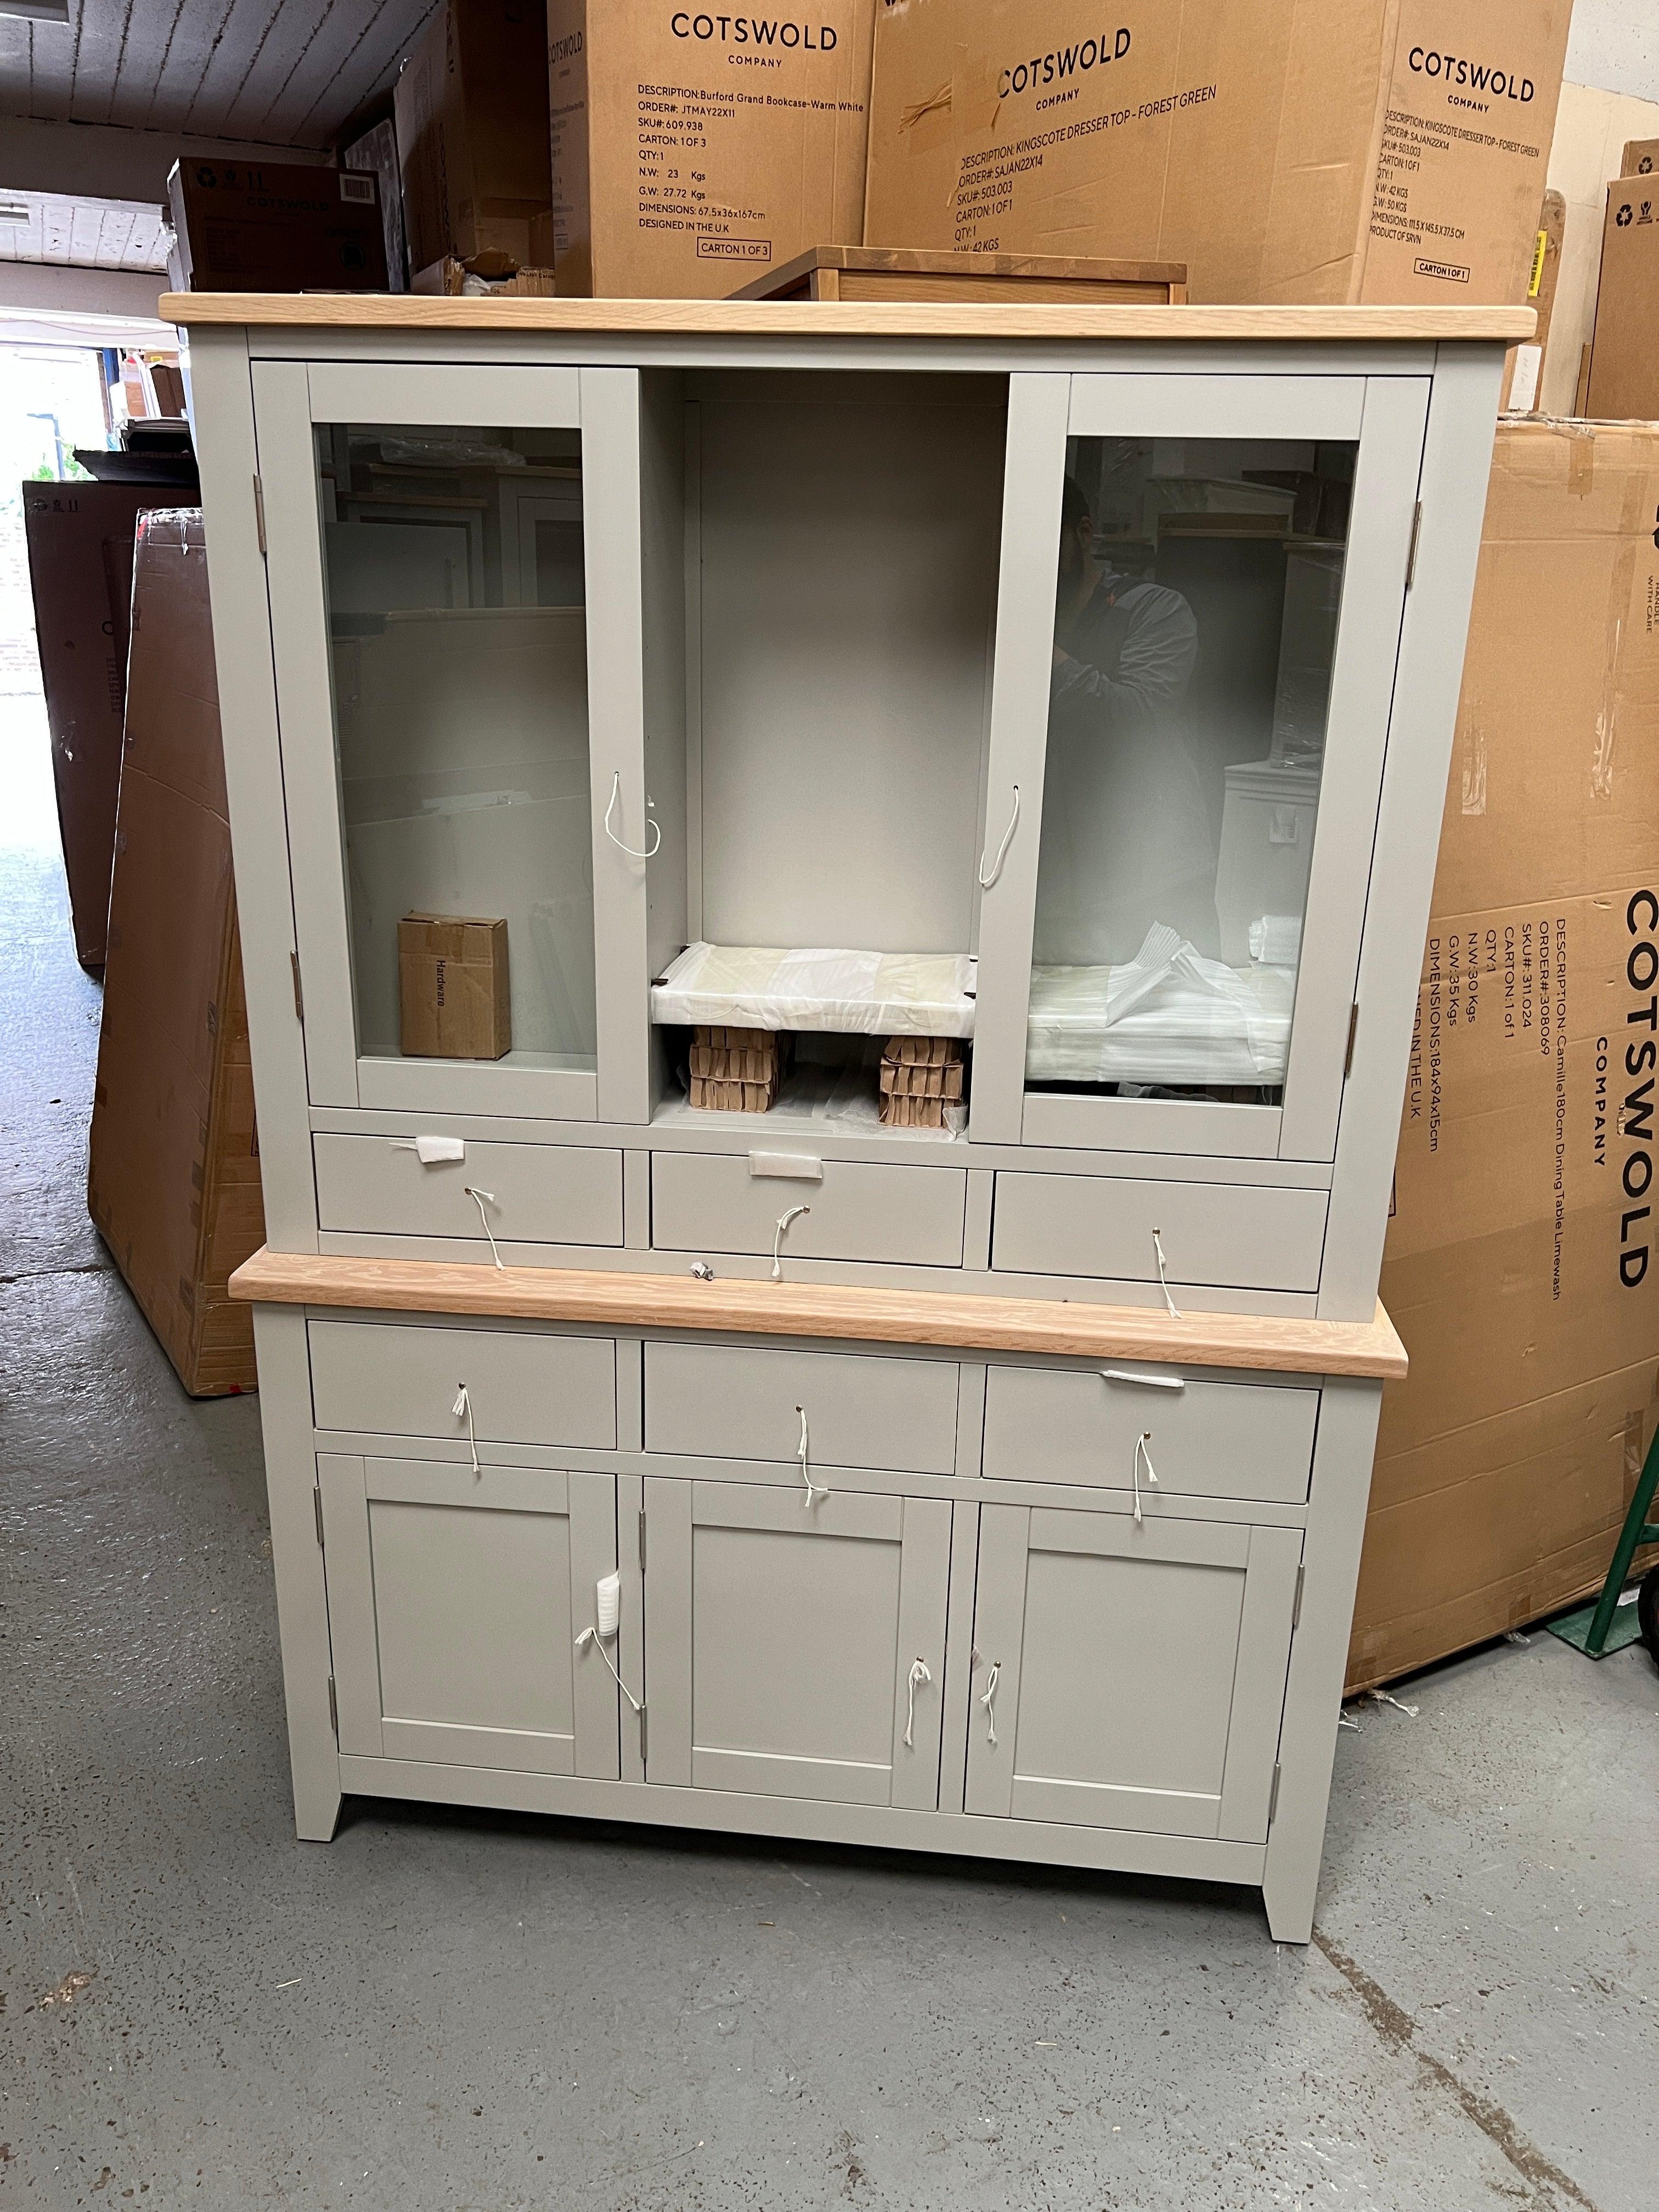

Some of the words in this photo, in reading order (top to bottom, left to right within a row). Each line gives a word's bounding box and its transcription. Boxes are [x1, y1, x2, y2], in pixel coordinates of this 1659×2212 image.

[671, 13, 837, 50] COTSWOLD
[729, 55, 782, 68] COMPANY
[998, 28, 1131, 98] COTSWOLD
[1408, 47, 1534, 103] COTSWOLD
[737, 93, 764, 104] Grand
[766, 95, 836, 110] Bookcase-Warm
[838, 101, 864, 112] White
[1036, 88, 1080, 111] COMPANY
[1447, 95, 1489, 113] COMPANY
[638, 101, 678, 113] ORDER#:
[681, 105, 735, 117] JTMAY22X11
[1016, 128, 1066, 154] KINGSCOTE
[1067, 116, 1108, 139] DRESSER
[1111, 110, 1130, 126] TOP
[1138, 95, 1178, 119] FOREST
[1179, 84, 1216, 107] GREEN
[639, 134, 678, 145] CARTON:
[701, 138, 706, 147] 3
[1425, 120, 1458, 137] KINGSCOTE
[1458, 128, 1483, 144] DRESSER
[1484, 135, 1496, 146] TOP
[1498, 139, 1520, 153] FOREST
[1520, 145, 1539, 157] GREEN
[668, 169, 679, 178] 23
[691, 171, 706, 182] Kgs
[663, 188, 686, 198] 27.72
[691, 190, 706, 201] Kgs
[981, 180, 1012, 199] 503.003
[1396, 187, 1408, 198] KGS
[247, 196, 329, 212] COTSWOLD
[639, 202, 697, 215] DIMENSIONS:
[698, 207, 765, 219] 67.5x36x167cm
[1387, 199, 1395, 210] 50
[1395, 201, 1407, 213] KGS
[639, 218, 684, 229] DESIGNED
[686, 222, 695, 230] IN
[697, 223, 713, 232] THE
[1455, 229, 1465, 239] CM
[983, 238, 999, 252] KGS
[1397, 231, 1406, 241] OF
[701, 243, 740, 253] CARTON
[742, 245, 745, 254] 1
[748, 246, 760, 255] OF
[763, 246, 768, 255] 3
[1419, 263, 1447, 275] CARTON
[1452, 269, 1461, 278] OF
[1447, 998, 1459, 1026] Kgs
[1466, 995, 1478, 1023] Kgs
[1505, 1013, 1514, 1028] of
[1411, 1054, 1421, 1088] THE
[1620, 889, 1658, 1288] COTSWOLD
[1410, 1091, 1421, 1119] U.K
[1594, 1036, 1608, 1166] COMPANY
[1554, 1143, 1565, 1189] Dining
[1556, 1190, 1565, 1228] Table
[1553, 1232, 1563, 1301] Limewash
